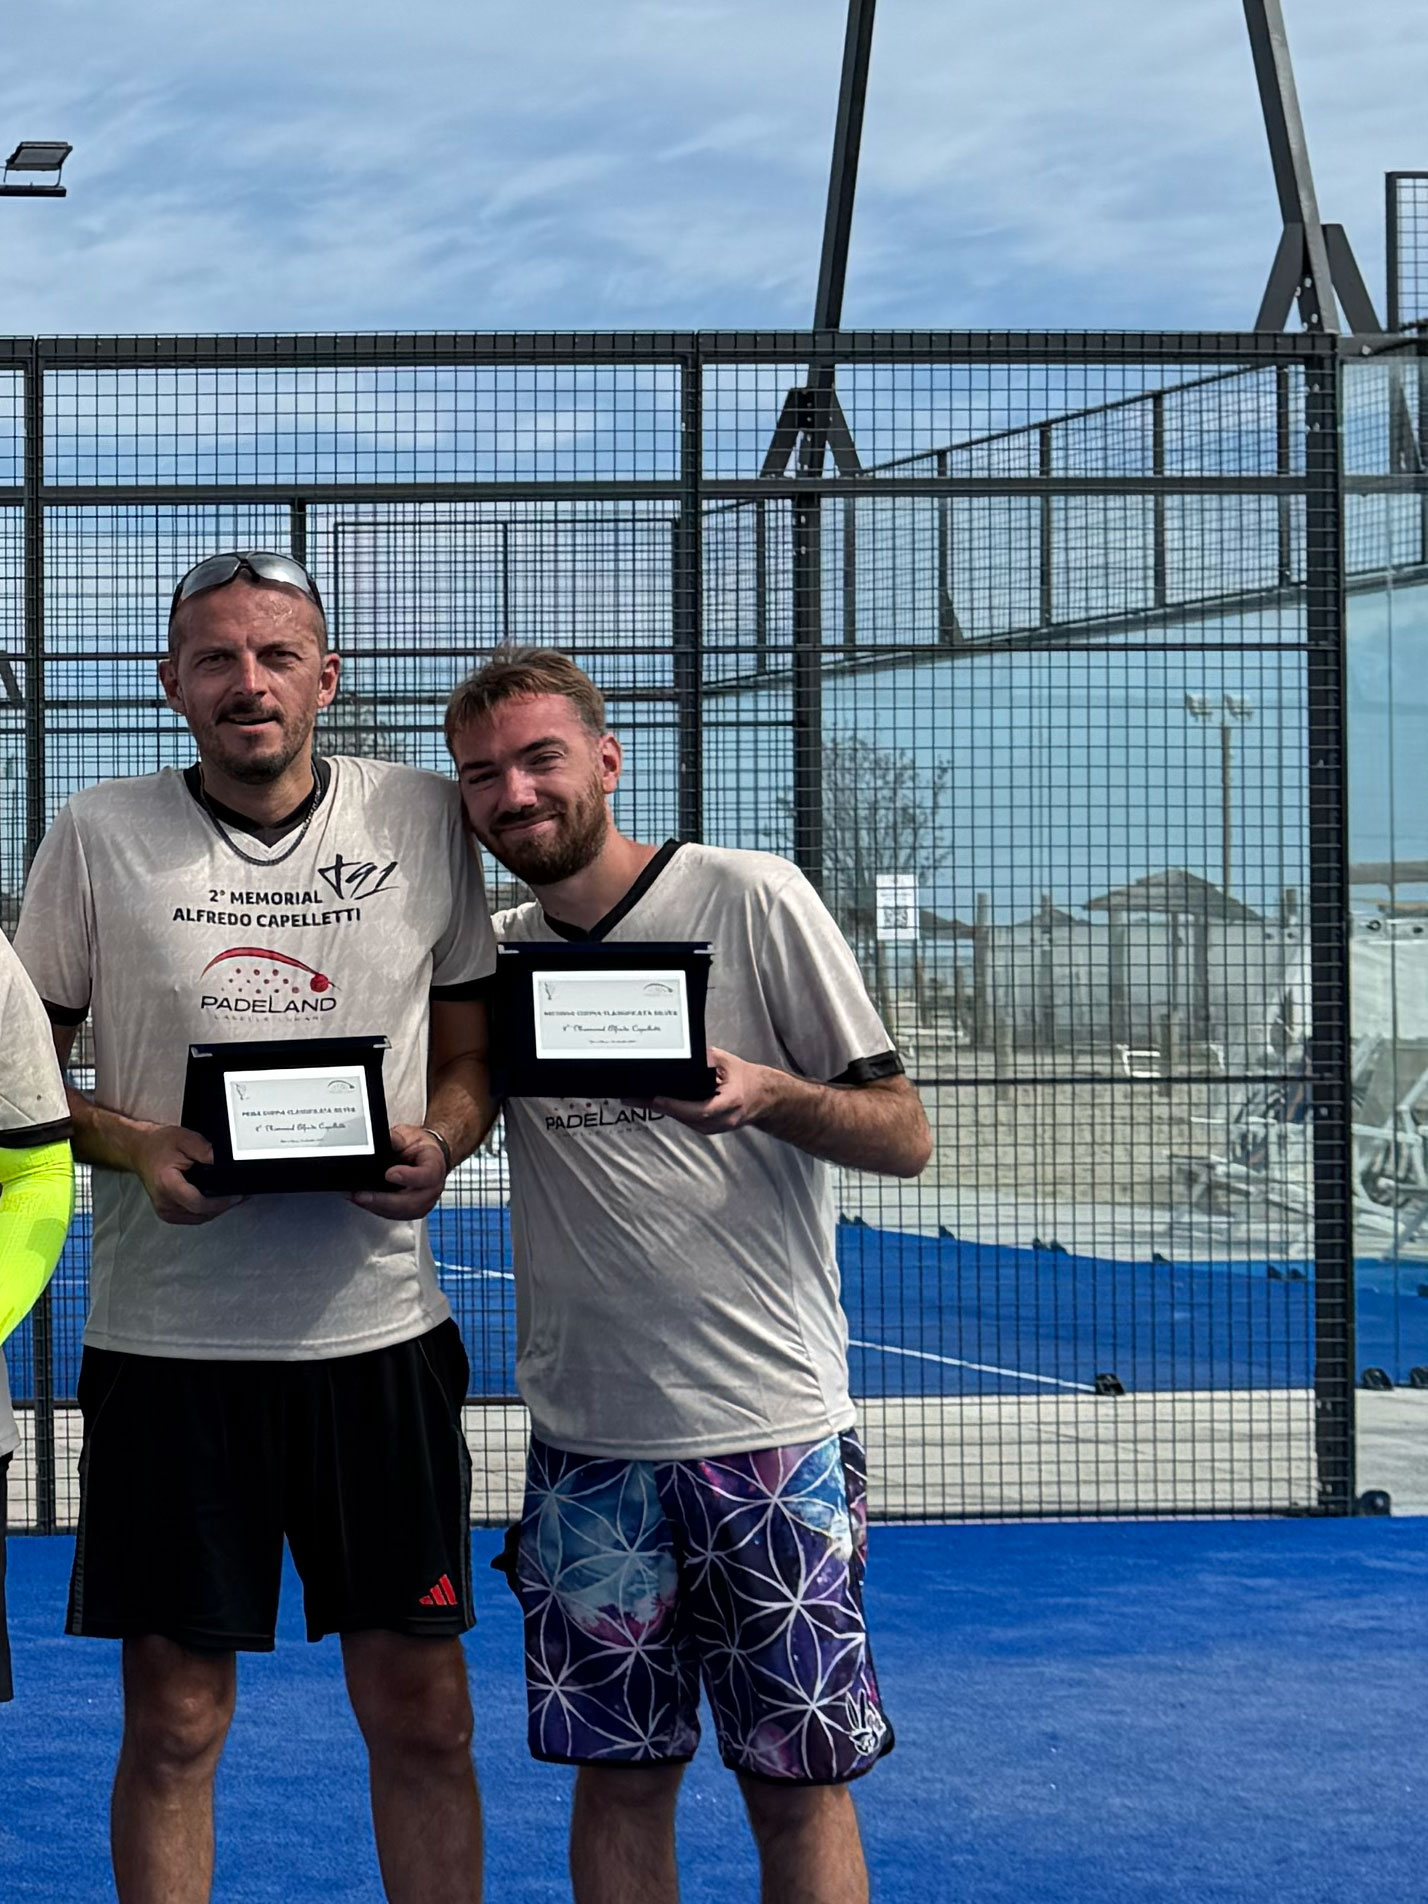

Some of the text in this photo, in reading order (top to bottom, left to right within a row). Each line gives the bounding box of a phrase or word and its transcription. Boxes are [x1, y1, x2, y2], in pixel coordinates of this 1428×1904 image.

[230, 889, 324, 905] MEMORIAL
[172, 907, 361, 928] ALFREDO CAPELLETTI
